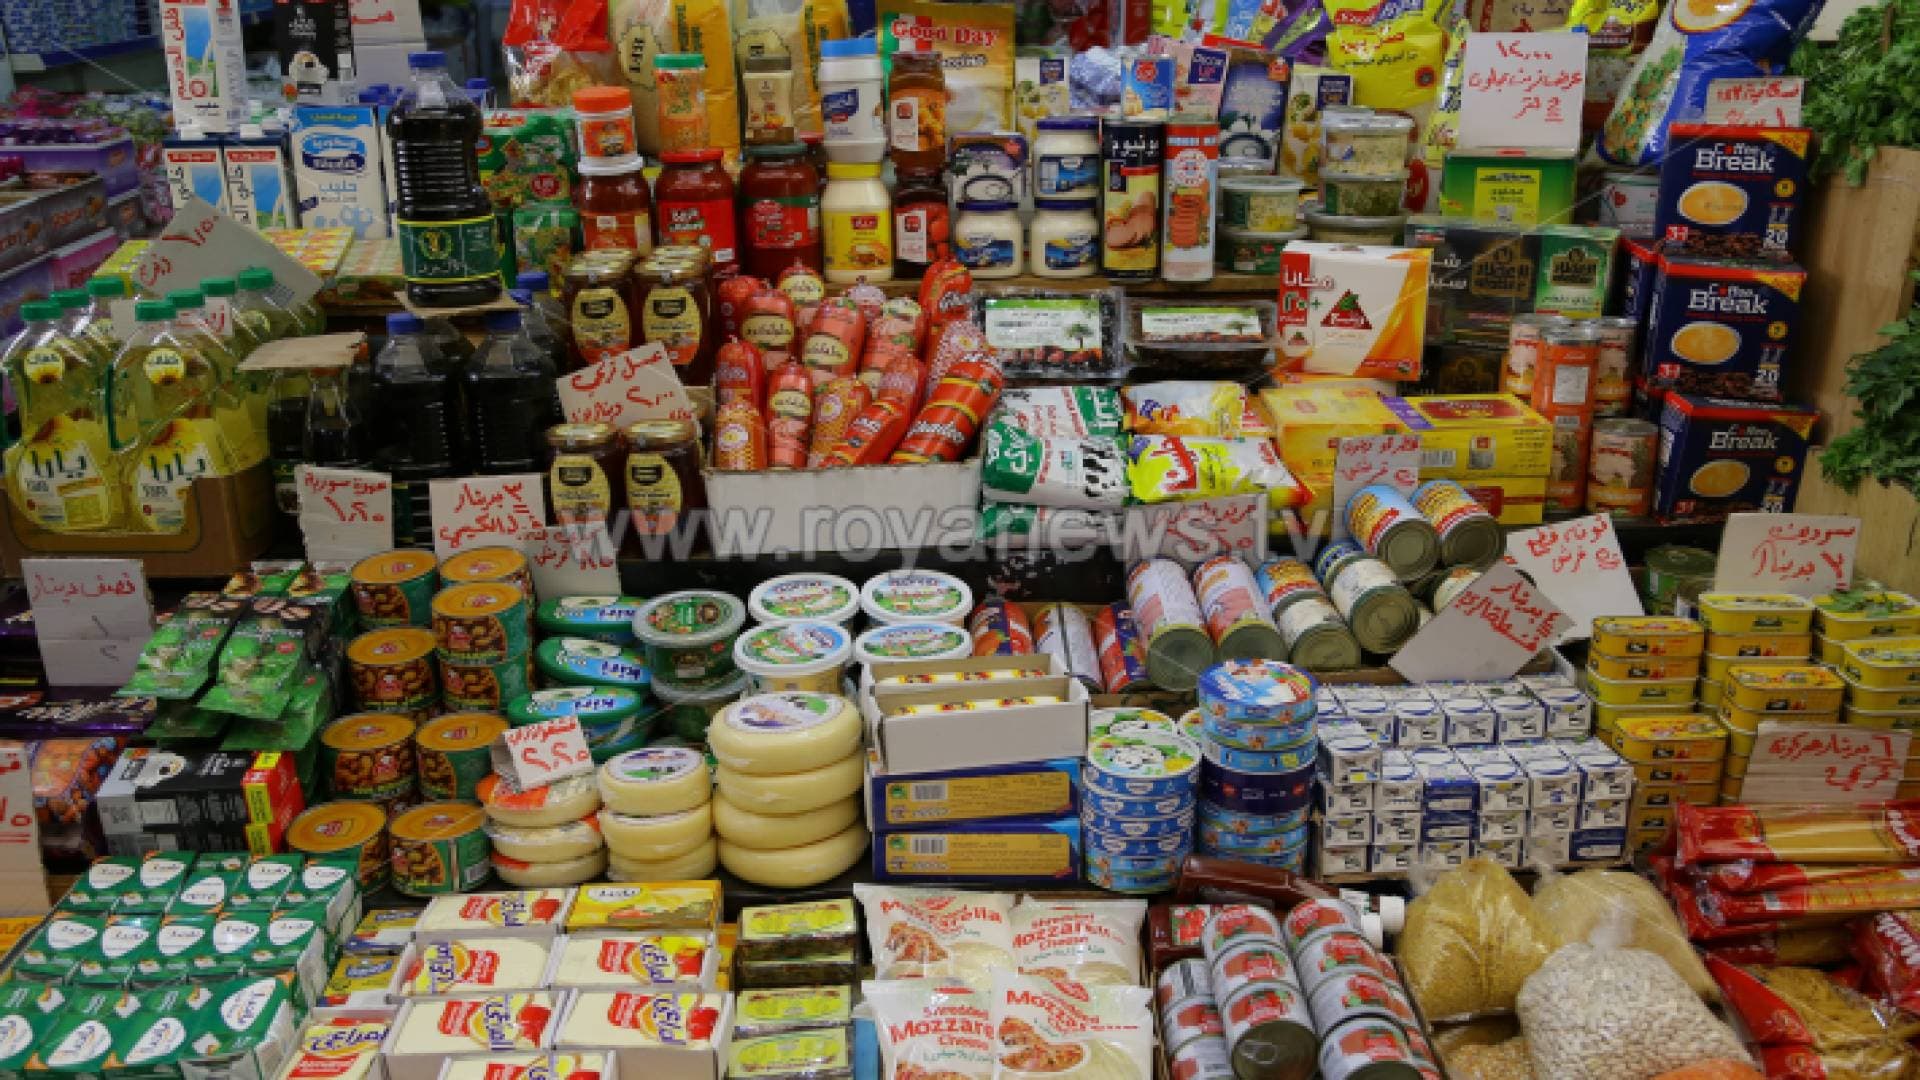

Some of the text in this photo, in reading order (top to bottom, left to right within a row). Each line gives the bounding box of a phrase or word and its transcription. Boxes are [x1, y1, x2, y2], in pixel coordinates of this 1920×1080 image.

[954, 27, 998, 47] Day
[1715, 142, 1760, 155] Coffee
[1694, 148, 1775, 172] Break
[1708, 283, 1754, 296] Coffee
[1688, 289, 1769, 314] Break
[1709, 431, 1780, 449] Break
[889, 1017, 995, 1045] Mozzare
